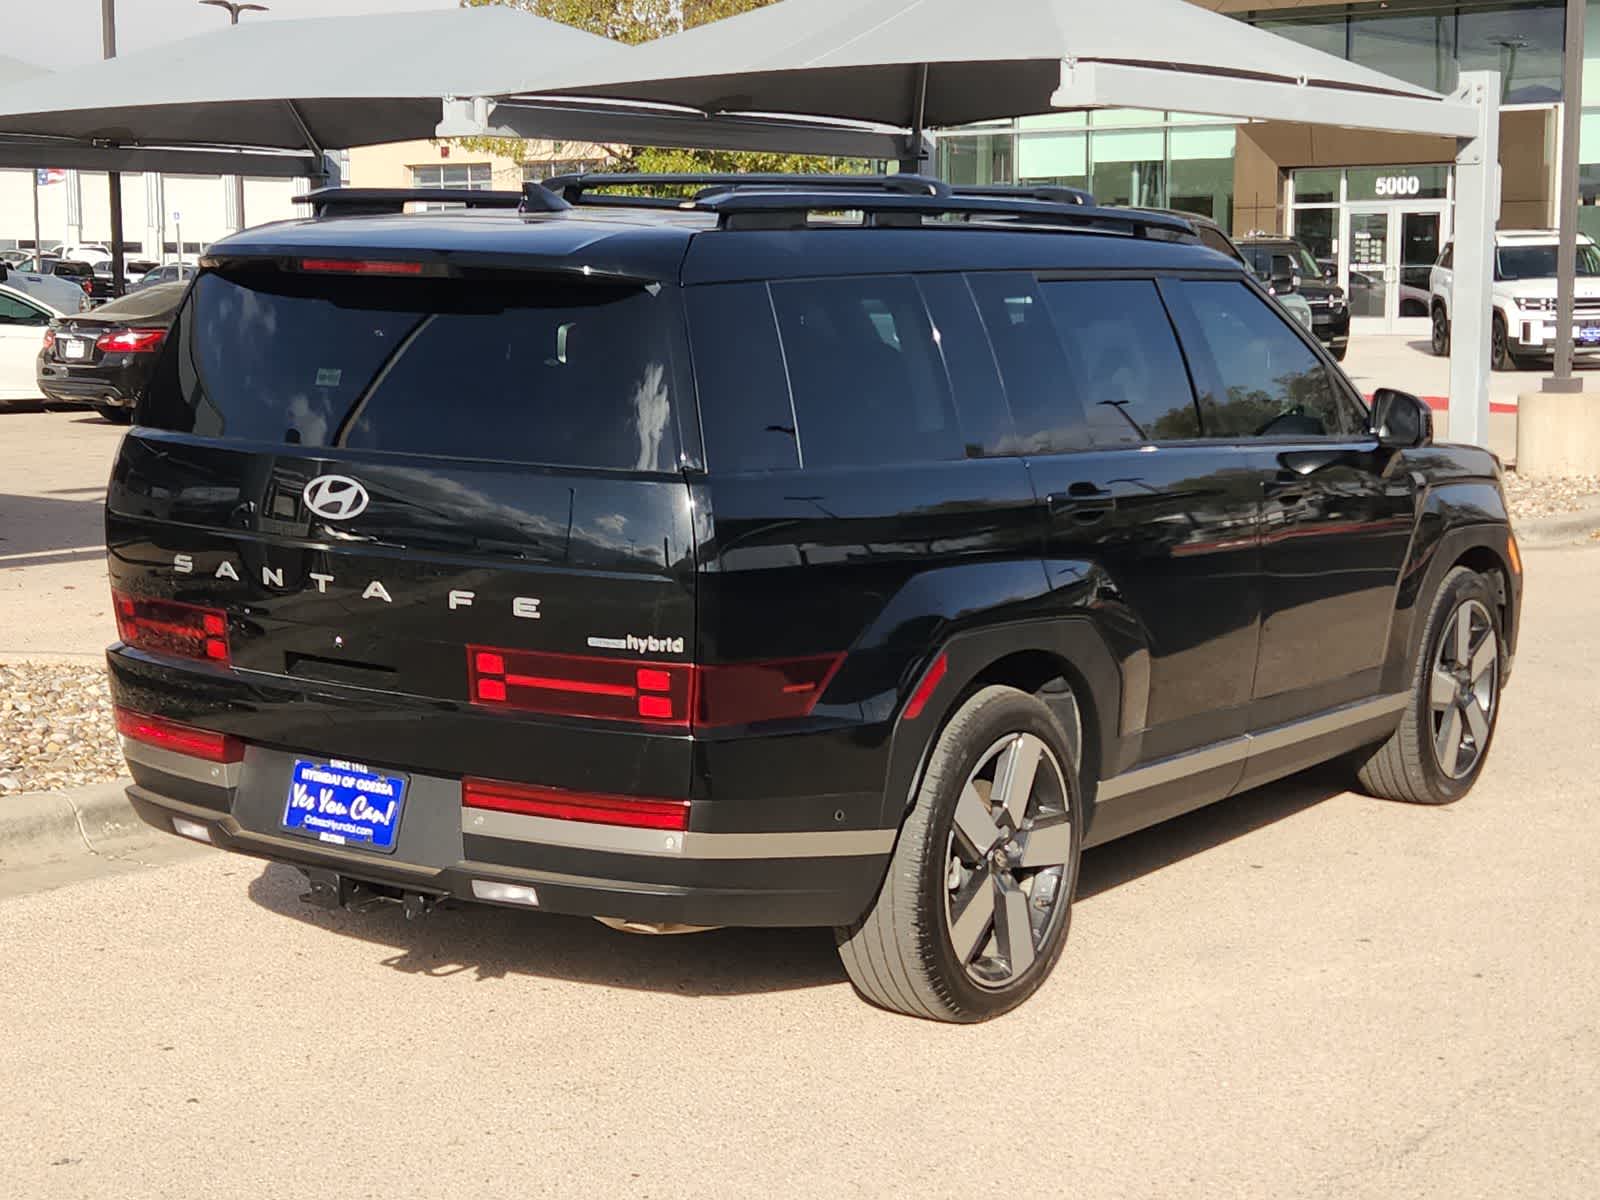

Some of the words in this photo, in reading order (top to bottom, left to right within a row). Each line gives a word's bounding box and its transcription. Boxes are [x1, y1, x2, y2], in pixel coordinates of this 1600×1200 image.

[1375, 176, 1420, 195] 5000
[174, 554, 392, 602] SANTA
[448, 590, 541, 619] FE
[626, 633, 684, 655] hybrid
[341, 776, 356, 788] OF
[291, 783, 316, 811] Yes
[318, 788, 348, 816] You
[350, 795, 395, 825] Can!
